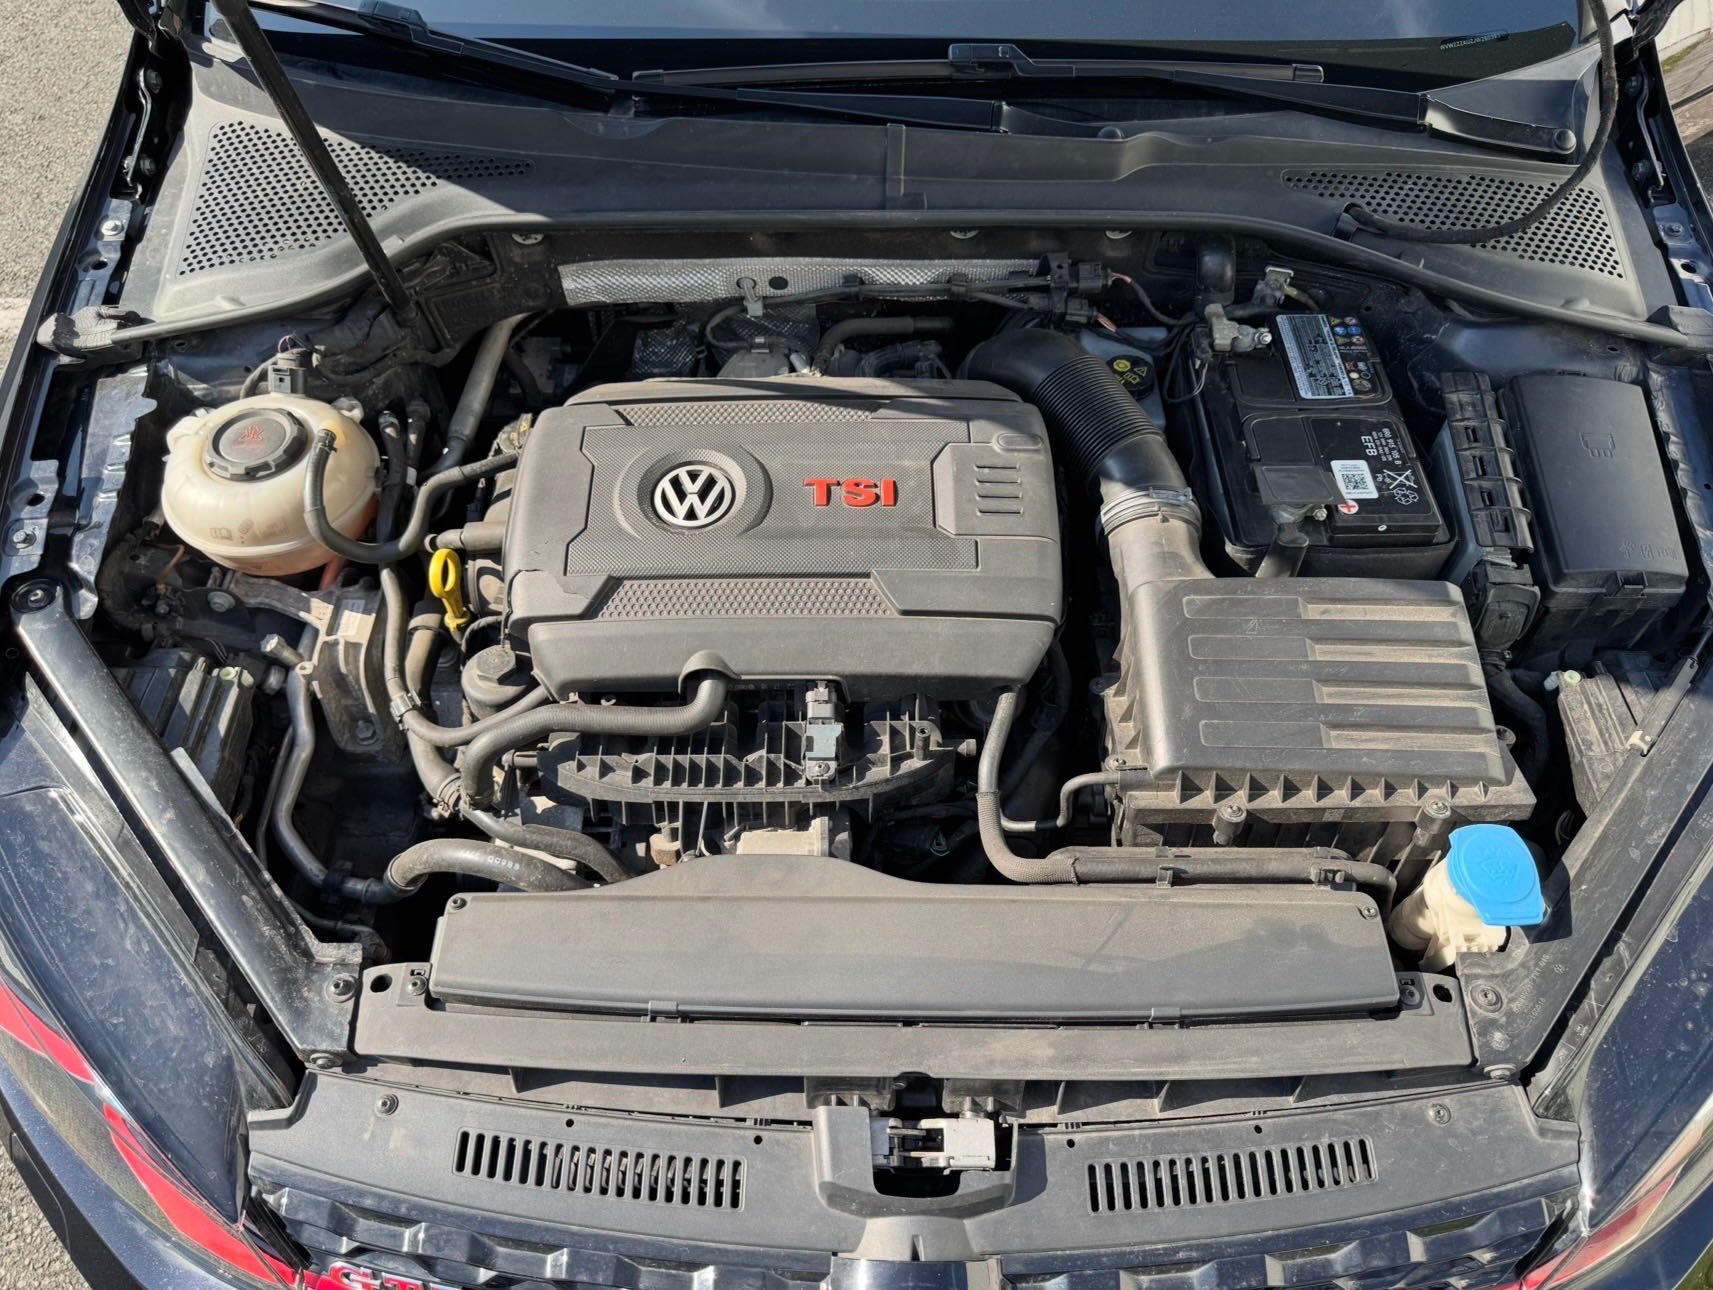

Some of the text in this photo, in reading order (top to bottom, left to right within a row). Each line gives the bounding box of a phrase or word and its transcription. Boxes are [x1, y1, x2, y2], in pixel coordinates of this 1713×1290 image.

[1361, 435, 1378, 456] EFB
[654, 464, 732, 528] VW
[803, 478, 898, 508] TSI
